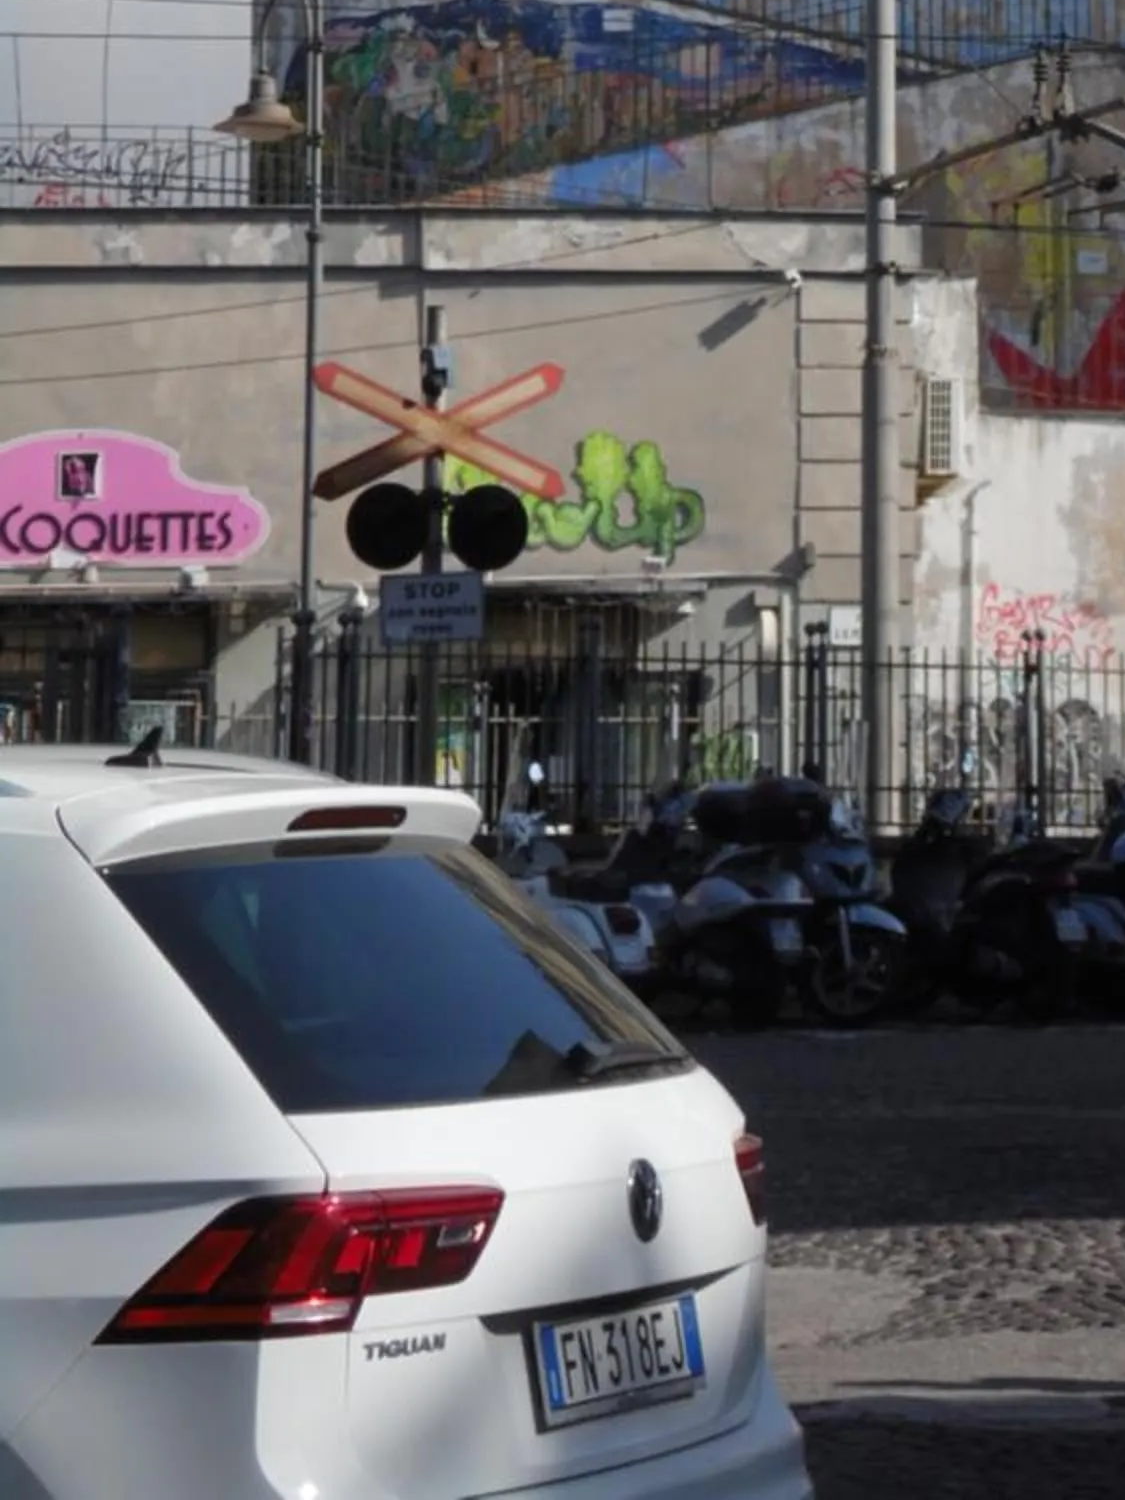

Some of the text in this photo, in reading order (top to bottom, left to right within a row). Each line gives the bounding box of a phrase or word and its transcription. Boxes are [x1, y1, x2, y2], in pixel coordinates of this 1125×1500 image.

[0, 503, 234, 554] COQUETTES
[404, 582, 461, 600] STOP
[363, 1332, 447, 1361] TIGUAN
